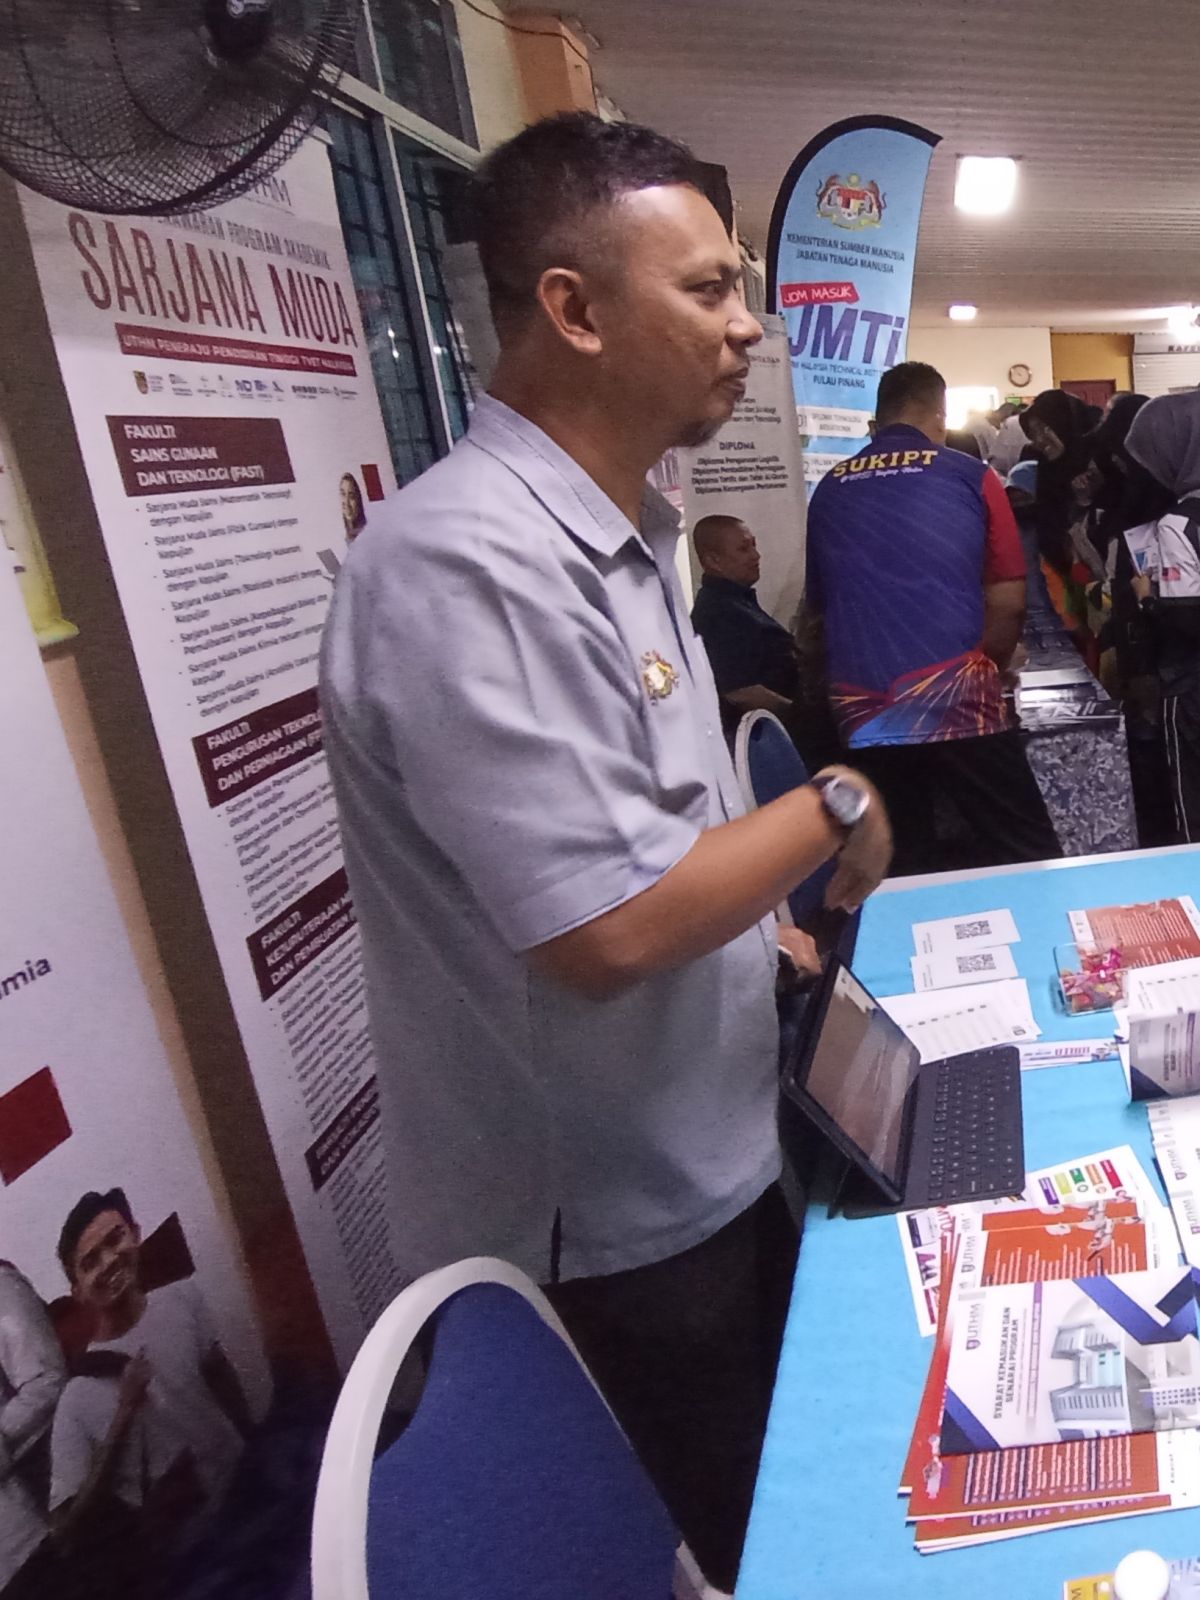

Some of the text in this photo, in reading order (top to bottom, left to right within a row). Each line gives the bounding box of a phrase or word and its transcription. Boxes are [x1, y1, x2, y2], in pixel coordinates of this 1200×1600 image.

[786, 233, 905, 261] KEMENTERIAN SUMBER MANUSIA
[796, 248, 894, 273] JABATAN TENAGA MANUSIA
[68, 212, 358, 348] SARJANA MUDA
[784, 285, 852, 303] JOM MASUK
[813, 374, 866, 389] PULAU PINANG
[124, 424, 177, 440] FAKULTI
[718, 441, 756, 450] DIPLOMA
[132, 447, 219, 463] SAINS GUNAAN
[833, 450, 939, 478] SUKIPT
[136, 471, 168, 487] DAN
[169, 468, 230, 485] TEKNOLOGI
[206, 721, 251, 750] FAKULTI
[212, 728, 283, 771] PENGURUSAN
[217, 770, 244, 791] DAN
[269, 959, 295, 986] DAN
[967, 1303, 981, 1339] UTHM
[993, 1306, 1011, 1419] SYARAT KEMASUKAN DAN
[1006, 1318, 1019, 1403] SENARAI PROGRAM
